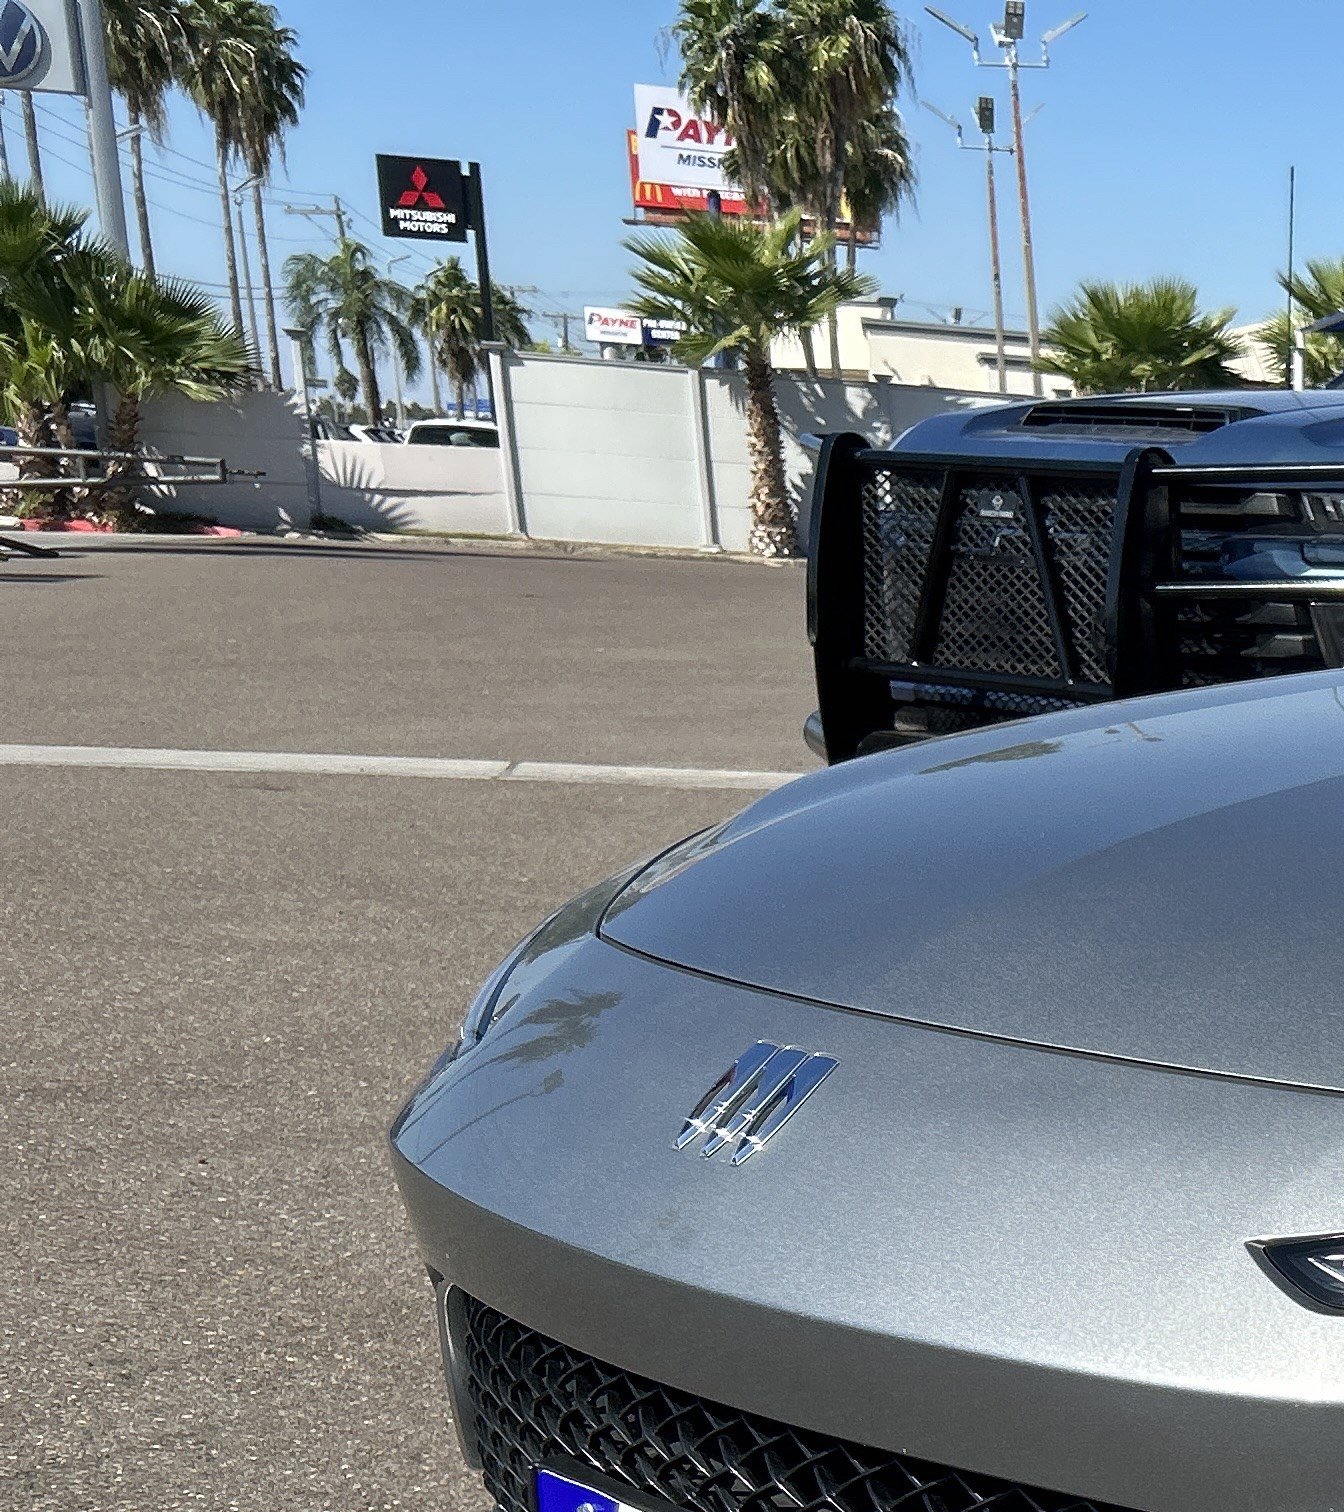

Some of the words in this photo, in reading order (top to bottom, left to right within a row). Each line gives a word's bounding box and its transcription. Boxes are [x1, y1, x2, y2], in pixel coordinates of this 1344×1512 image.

[645, 107, 737, 146] PAY
[390, 208, 456, 223] MITSUBISHI
[399, 220, 449, 233] MOTORS
[587, 312, 637, 329] PAYNE
